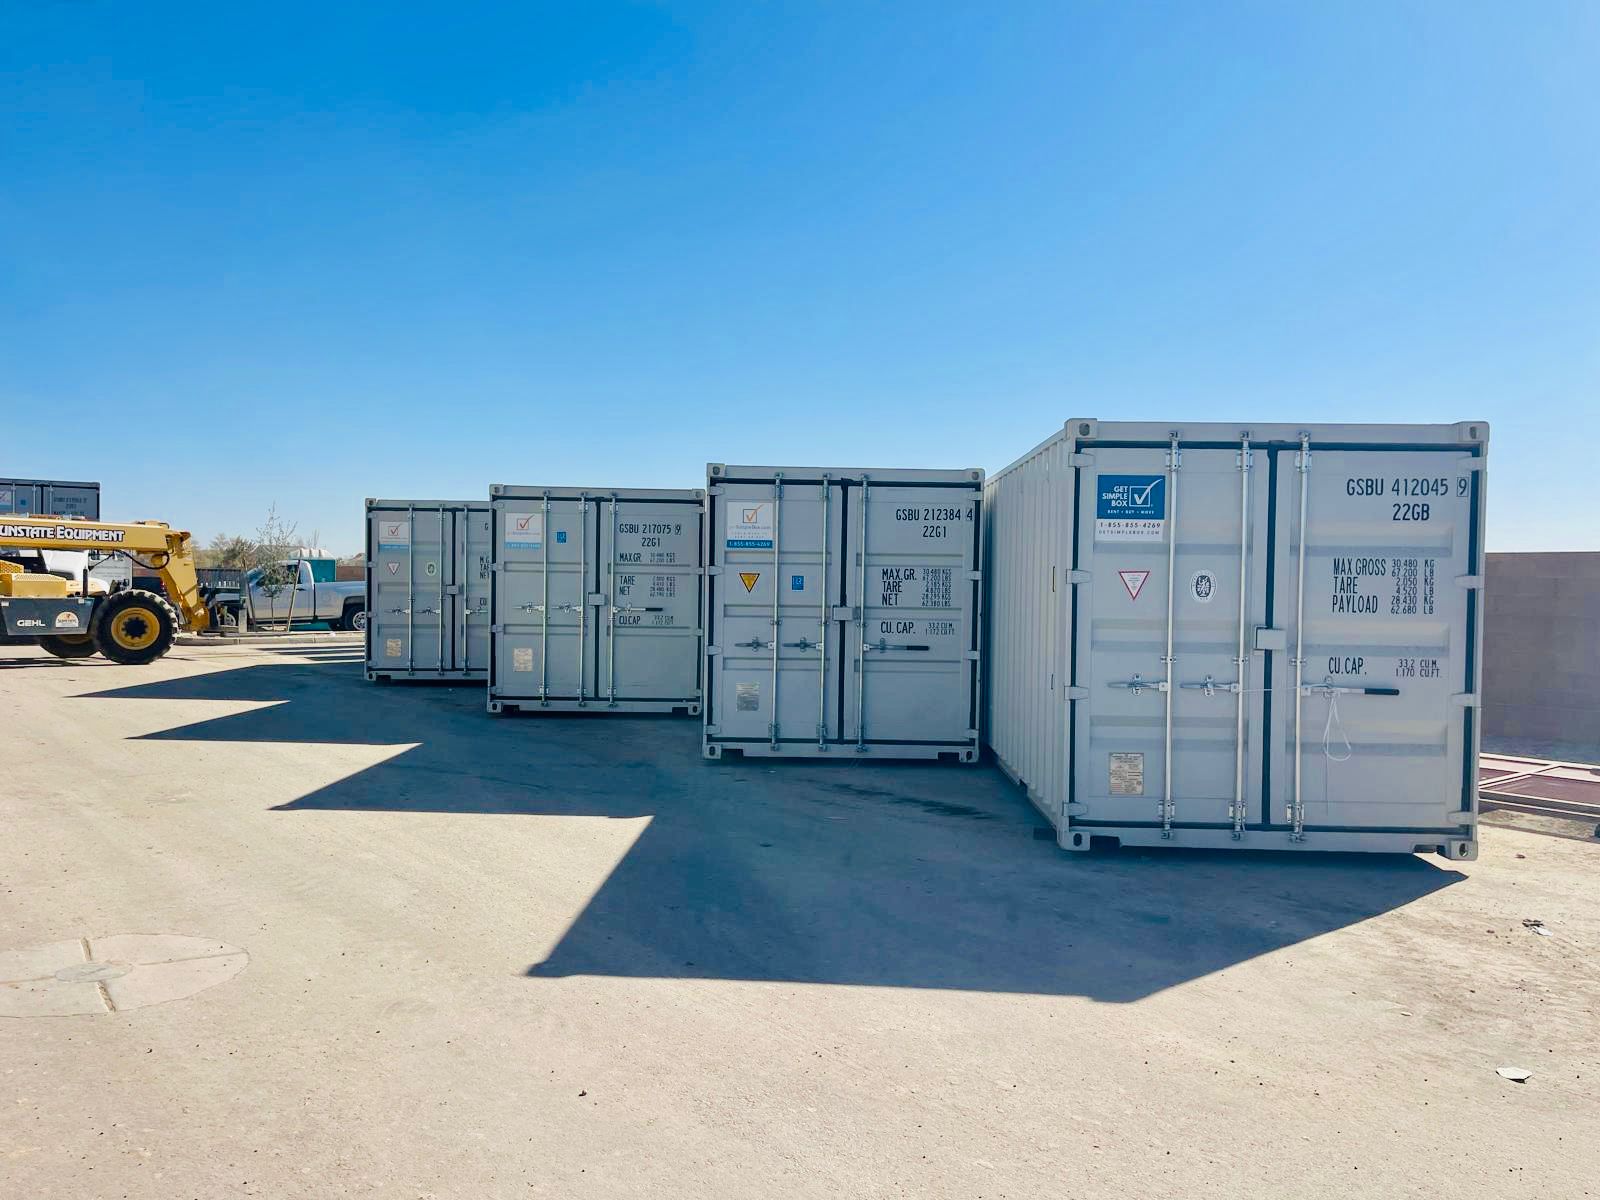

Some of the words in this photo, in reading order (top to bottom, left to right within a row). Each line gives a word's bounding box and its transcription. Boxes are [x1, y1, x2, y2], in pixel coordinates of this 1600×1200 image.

[1346, 478, 1384, 496] GSBU
[1391, 478, 1449, 496] 412045
[1458, 478, 1467, 495] 9
[896, 508, 920, 520] GSBU
[924, 508, 960, 520] 212384
[966, 508, 973, 521] 4
[1392, 503, 1430, 521] 22GB
[56, 525, 124, 542] EQUIPMENT
[620, 523, 639, 534] GSBU
[642, 524, 672, 534] 217075
[674, 524, 681, 534] 9
[923, 526, 946, 538] 22G1
[642, 537, 660, 547] 22G1
[1333, 558, 1353, 576] MAX
[1355, 558, 1386, 576] GROSS
[1424, 560, 1435, 568] KG
[1424, 568, 1434, 577] LB
[620, 576, 636, 586] TARE
[882, 580, 903, 592] TARE
[1334, 576, 1358, 594] TARE
[1424, 578, 1434, 586] KG
[620, 586, 630, 596] NET
[1424, 586, 1434, 596] LB
[882, 593, 898, 606] NET
[1332, 595, 1378, 613] PAYLOAD
[1424, 596, 1434, 604] KG
[1424, 606, 1434, 614] LB
